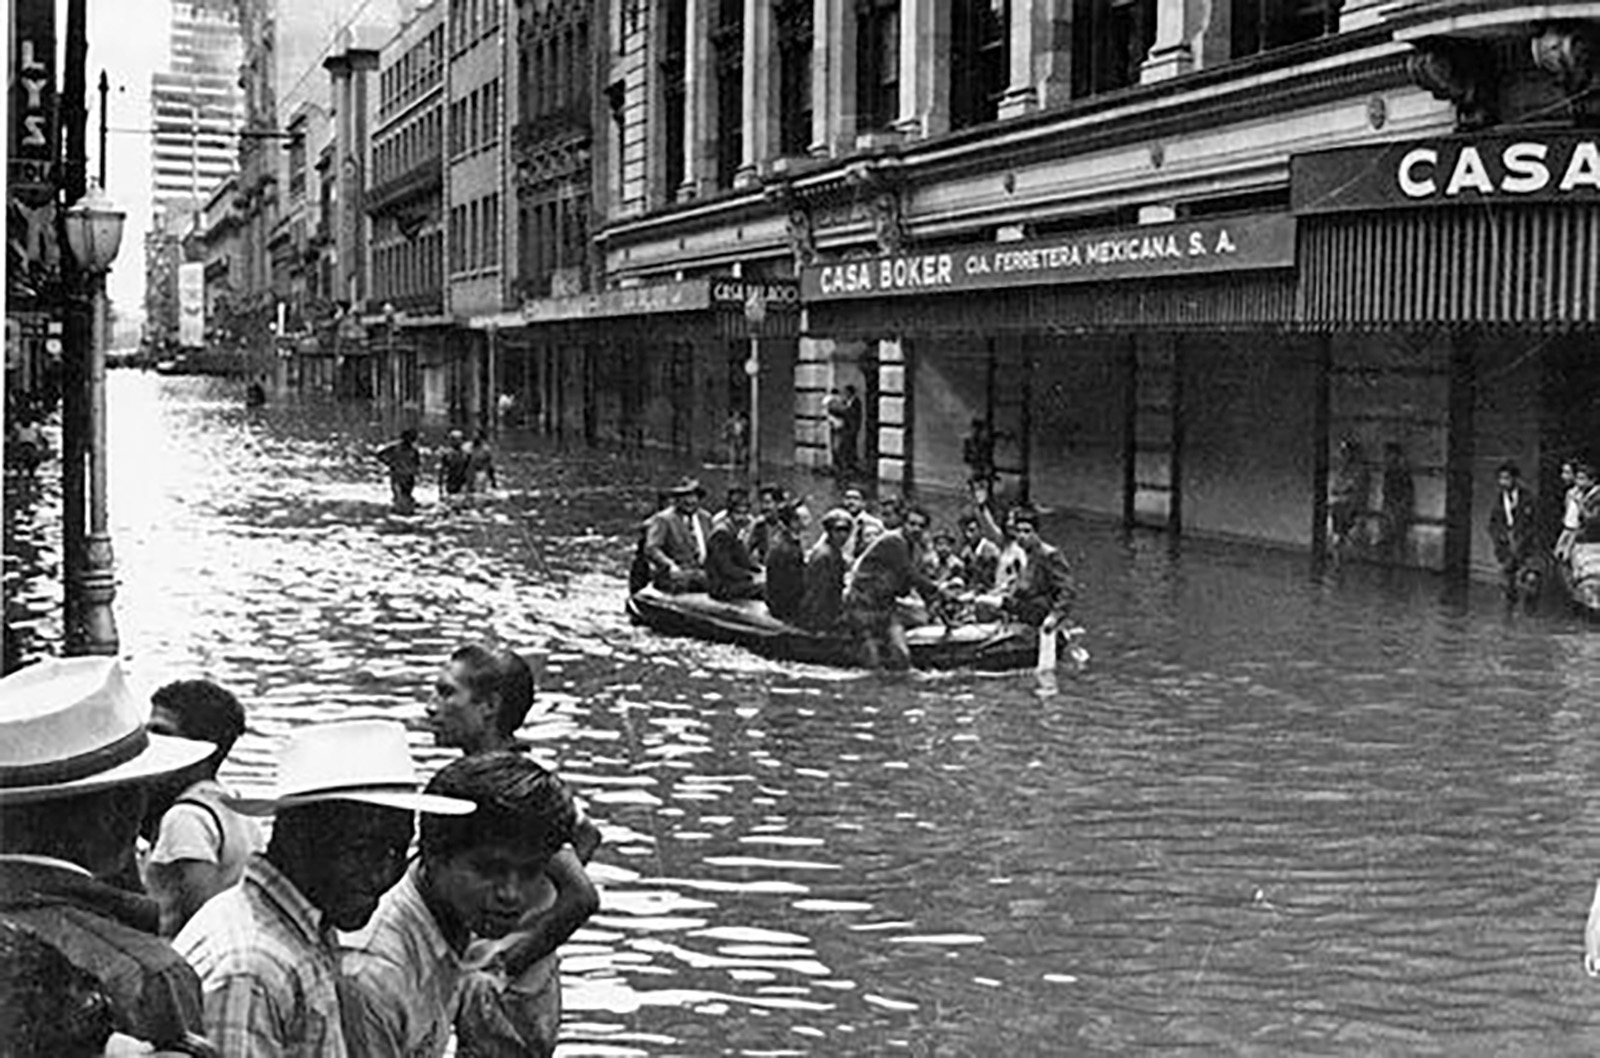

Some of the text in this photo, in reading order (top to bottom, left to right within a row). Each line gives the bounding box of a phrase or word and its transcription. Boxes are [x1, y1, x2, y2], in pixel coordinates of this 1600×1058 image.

[1398, 142, 1600, 197] CASA
[819, 262, 872, 295] CASA
[880, 254, 953, 289] BOKER
[994, 245, 1082, 272] FERRETERA
[1188, 231, 1207, 255] S.
[1214, 229, 1237, 254] A.
[713, 282, 744, 301] CASA
